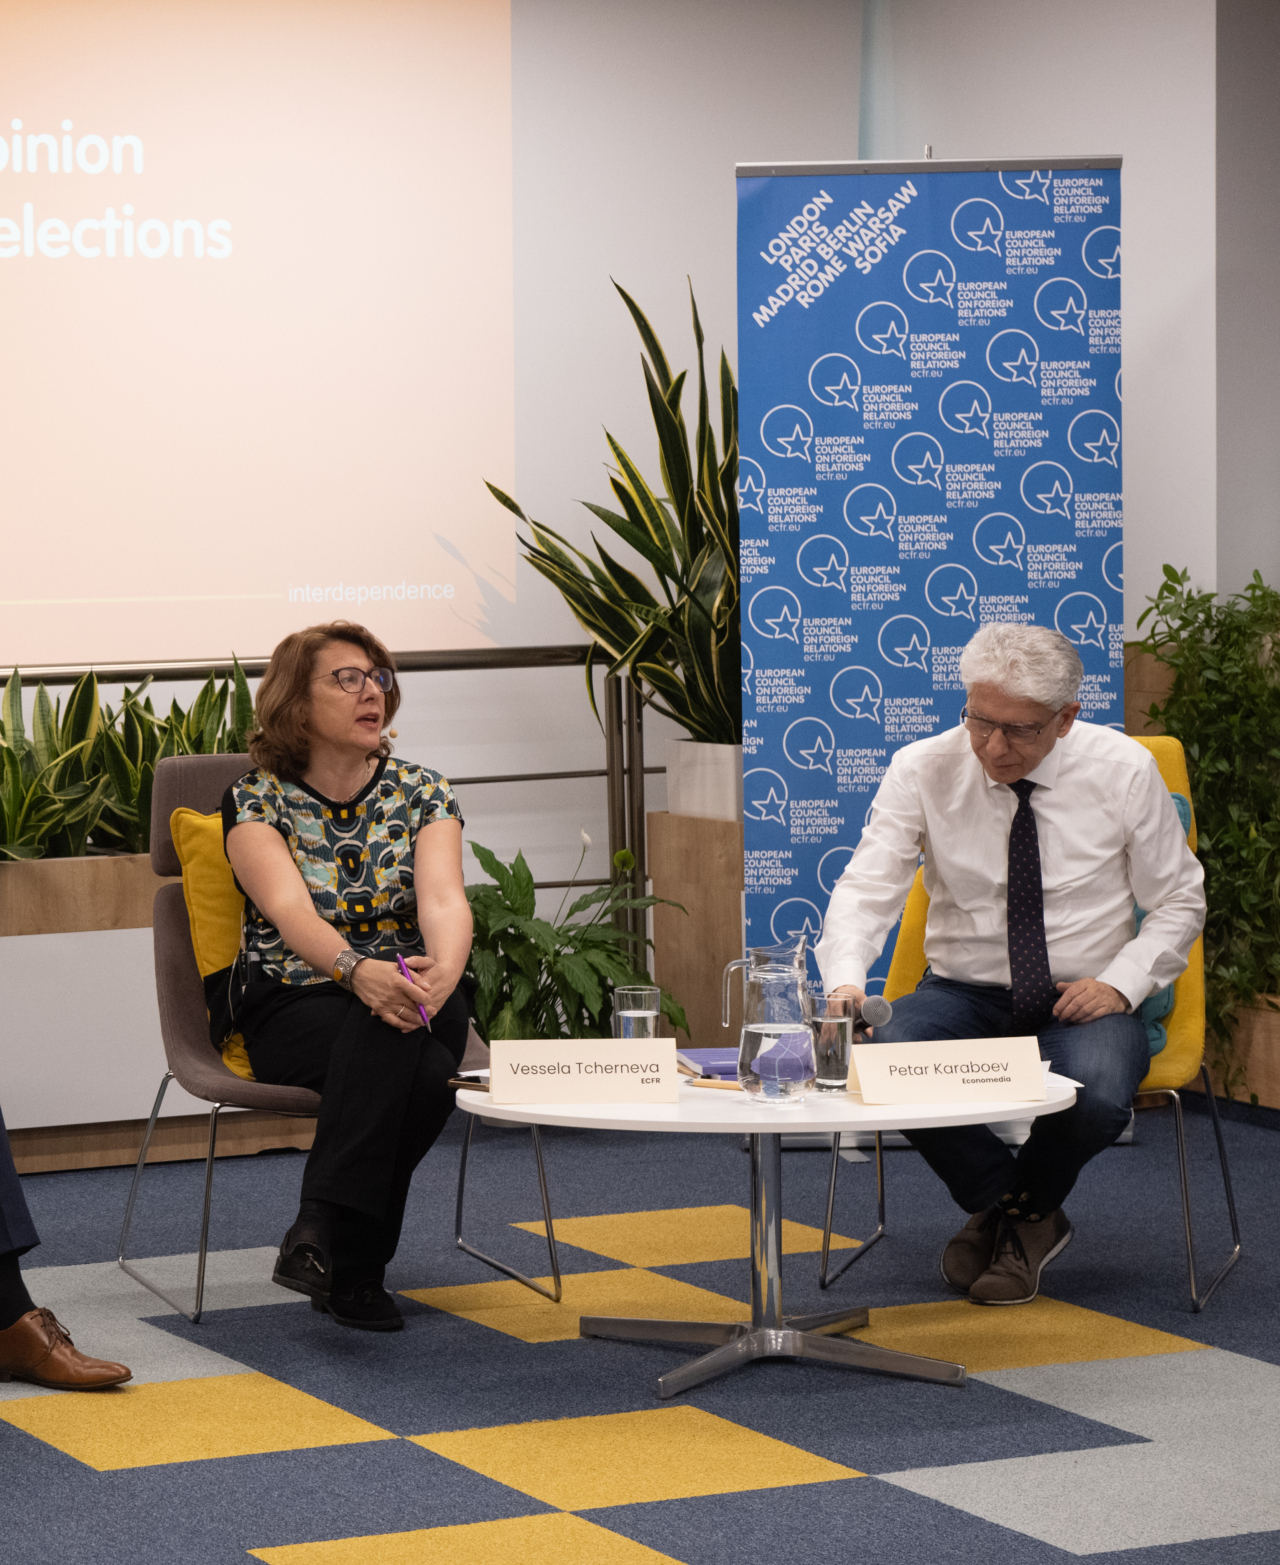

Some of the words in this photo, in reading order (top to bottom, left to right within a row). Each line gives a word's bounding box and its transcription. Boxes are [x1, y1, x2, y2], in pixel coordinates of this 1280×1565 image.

[1053, 178, 1102, 187] EUROPEAN
[1053, 187, 1094, 196] COUNCIL
[1054, 196, 1068, 205] ON
[1070, 196, 1109, 204] FOREIGN
[1054, 205, 1102, 214] RELATIONS
[1054, 214, 1086, 223] ecfr.eu
[760, 190, 834, 265] LONDON
[1005, 230, 1054, 239] EUROPEAN
[779, 221, 828, 272] PARIS
[796, 255, 847, 309] ROME
[842, 180, 918, 258] WARSAW
[1005, 239, 1046, 248] COUNCIL
[855, 224, 906, 274] SOFIA
[1006, 248, 1020, 257] ON
[1022, 247, 1061, 256] FOREIGN
[752, 258, 818, 328] MADRID
[816, 200, 875, 260] BERLIN
[1006, 257, 1054, 266] RELATIONS
[1006, 266, 1038, 275] ecfr.eu
[958, 282, 1007, 290] EUROPEAN
[958, 290, 998, 300] COUNCIL
[958, 300, 972, 308] ON
[974, 299, 1013, 308] FOREIGN
[958, 308, 1007, 318] RELATIONS
[958, 318, 990, 326] ecfr.eu
[910, 333, 959, 342] EUROPEAN
[910, 342, 951, 351] COUNCIL
[910, 352, 925, 360] ON
[927, 351, 966, 360] FOREIGN
[911, 360, 959, 369] RELATIONS
[1041, 360, 1090, 370] EUROPEAN
[911, 369, 943, 378] ecfr.eu
[1041, 370, 1081, 378] COUNCIL
[1041, 379, 1055, 388] ON
[1057, 378, 1096, 387] FOREIGN
[863, 384, 912, 394] EUROPEAN
[1041, 388, 1090, 396] RELATIONS
[863, 394, 903, 402] COUNCIL
[1041, 396, 1073, 405] ecfr.eu
[863, 403, 877, 412] ON
[879, 402, 918, 411] FOREIGN
[863, 412, 912, 420] RELATIONS
[993, 412, 1042, 421] EUROPEAN
[863, 420, 895, 429] ecfr.eu
[993, 421, 1034, 430] COUNCIL
[993, 430, 1008, 439] ON
[1010, 430, 1049, 438] FOREIGN
[815, 436, 864, 445] EUROPEAN
[994, 439, 1042, 448] RELATIONS
[815, 445, 855, 454] COUNCIL
[994, 448, 1026, 457] ecfr.eu
[815, 454, 830, 463] ON
[832, 454, 870, 462] FOREIGN
[816, 463, 864, 472] RELATIONS
[946, 464, 995, 472] EUROPEAN
[816, 472, 847, 480] ecfr.eu
[946, 472, 986, 482] COUNCIL
[946, 482, 960, 490] ON
[962, 481, 1001, 490] FOREIGN
[768, 487, 817, 496] EUROPEAN
[946, 490, 995, 500] RELATIONS
[768, 496, 808, 505] COUNCIL
[946, 500, 978, 508] ecfr.eu
[768, 506, 782, 514] ON
[784, 505, 823, 514] FOREIGN
[768, 514, 817, 523] RELATIONS
[898, 515, 947, 524] EUROPEAN
[768, 523, 800, 532] ecfr.eu
[898, 524, 938, 533] COUNCIL
[898, 533, 913, 541] ON
[915, 532, 953, 541] FOREIGN
[899, 541, 947, 550] RELATIONS
[1027, 544, 1076, 553] EUROPEAN
[899, 550, 930, 559] ecfr.eu
[1027, 553, 1068, 562] COUNCIL
[851, 566, 900, 575] EUROPEAN
[1027, 562, 1042, 571] ON
[1044, 561, 1083, 570] FOREIGN
[851, 575, 891, 584] COUNCIL
[1028, 571, 1076, 580] RELATIONS
[851, 584, 865, 593] ON
[867, 583, 906, 592] FOREIGN
[1028, 580, 1060, 589] ecfr.eu
[287, 581, 455, 605] interdependence
[851, 593, 900, 602] RELATIONS
[851, 602, 883, 611] ecfr.eu
[803, 617, 851, 626] EUROPEAN
[803, 626, 843, 635] COUNCIL
[803, 636, 817, 644] ON
[819, 635, 858, 643] FOREIGN
[804, 644, 851, 653] RELATIONS
[804, 653, 835, 661] ecfr.eu
[755, 668, 804, 677] EUROPEAN
[755, 677, 796, 686] COUNCIL
[756, 687, 770, 695] ON
[772, 686, 811, 695] FOREIGN
[756, 695, 804, 704] RELATIONS
[885, 697, 932, 706] EUROPEAN
[756, 704, 788, 713] ecfr.eu
[885, 706, 924, 715] COUNCIL
[885, 715, 899, 724] ON
[901, 715, 939, 723] FOREIGN
[885, 724, 932, 732] RELATIONS
[885, 732, 916, 741] ecfr.eu
[790, 799, 838, 808] EUROPEAN
[790, 808, 830, 817] COUNCIL
[790, 818, 804, 826] ON
[806, 817, 844, 825] FOREIGN
[790, 826, 838, 835] RELATIONS
[790, 835, 822, 843] ecfr.eu
[510, 1061, 571, 1075] Vessela
[575, 1061, 659, 1075] Tcherneva
[888, 1062, 930, 1077] Petar
[933, 1060, 1010, 1075] Karaboev
[962, 1075, 1012, 1084] Economedia
